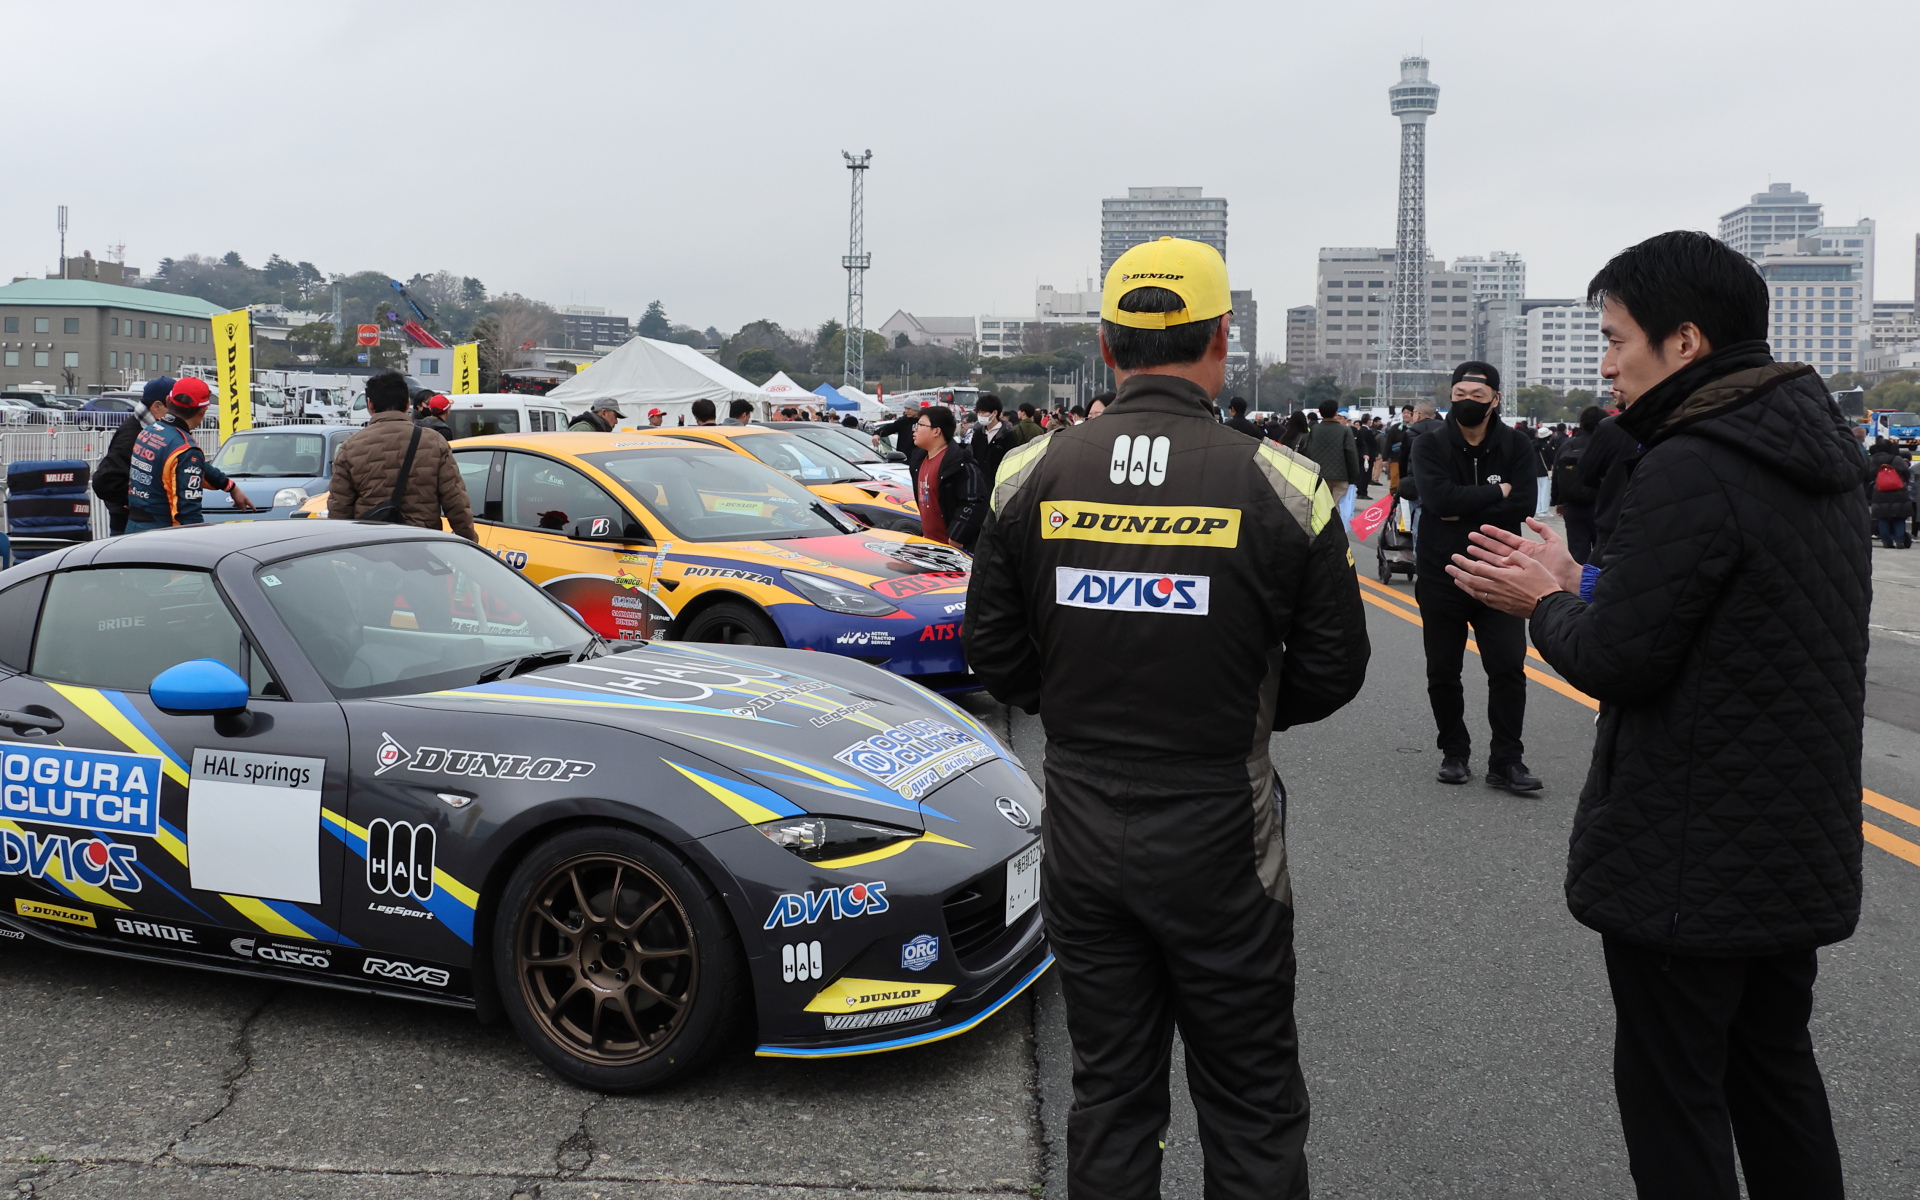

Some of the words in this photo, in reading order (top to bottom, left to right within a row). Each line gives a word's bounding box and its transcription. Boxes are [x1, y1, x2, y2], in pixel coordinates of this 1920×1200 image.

[1130, 273, 1184, 281] DUNLOP
[359, 331, 378, 339] ENEOS
[1113, 459, 1163, 473] HAL
[45, 473, 74, 483] VALFEE
[1072, 512, 1229, 535] DUNLOP
[615, 577, 641, 587] SUNOCO
[683, 566, 775, 587] POTENZA
[888, 575, 940, 598] ATS
[1067, 575, 1196, 610] ADVIOS
[98, 616, 145, 631] BRIDE
[920, 624, 955, 641] ATS
[749, 680, 831, 711] DUNLOP
[809, 700, 877, 728] LegSport
[867, 718, 951, 752] OGURA
[894, 729, 978, 767] CLUTCH
[4, 754, 149, 794] OGURA
[203, 755, 239, 777] HAL
[243, 761, 311, 788] springs
[408, 747, 596, 782] DUNLOP
[900, 769, 938, 800] Ogura
[936, 755, 971, 778] Racing
[965, 745, 996, 761] Clutch
[4, 784, 148, 826] CLUTCH
[0, 829, 142, 892] DVIOS
[371, 857, 429, 881] HAL
[32, 906, 89, 922] DUNLOP
[368, 902, 434, 920] LegSport
[764, 881, 889, 929] ADVIOS
[114, 918, 198, 944] BRIDE
[257, 947, 330, 969] CUSCO
[301, 947, 326, 955] EQUIPMENT
[904, 940, 937, 960] ORC
[363, 957, 450, 987] RAYS
[785, 961, 820, 973] HAL
[859, 989, 921, 1004] DUNLOP
[869, 1000, 938, 1028] RACING
